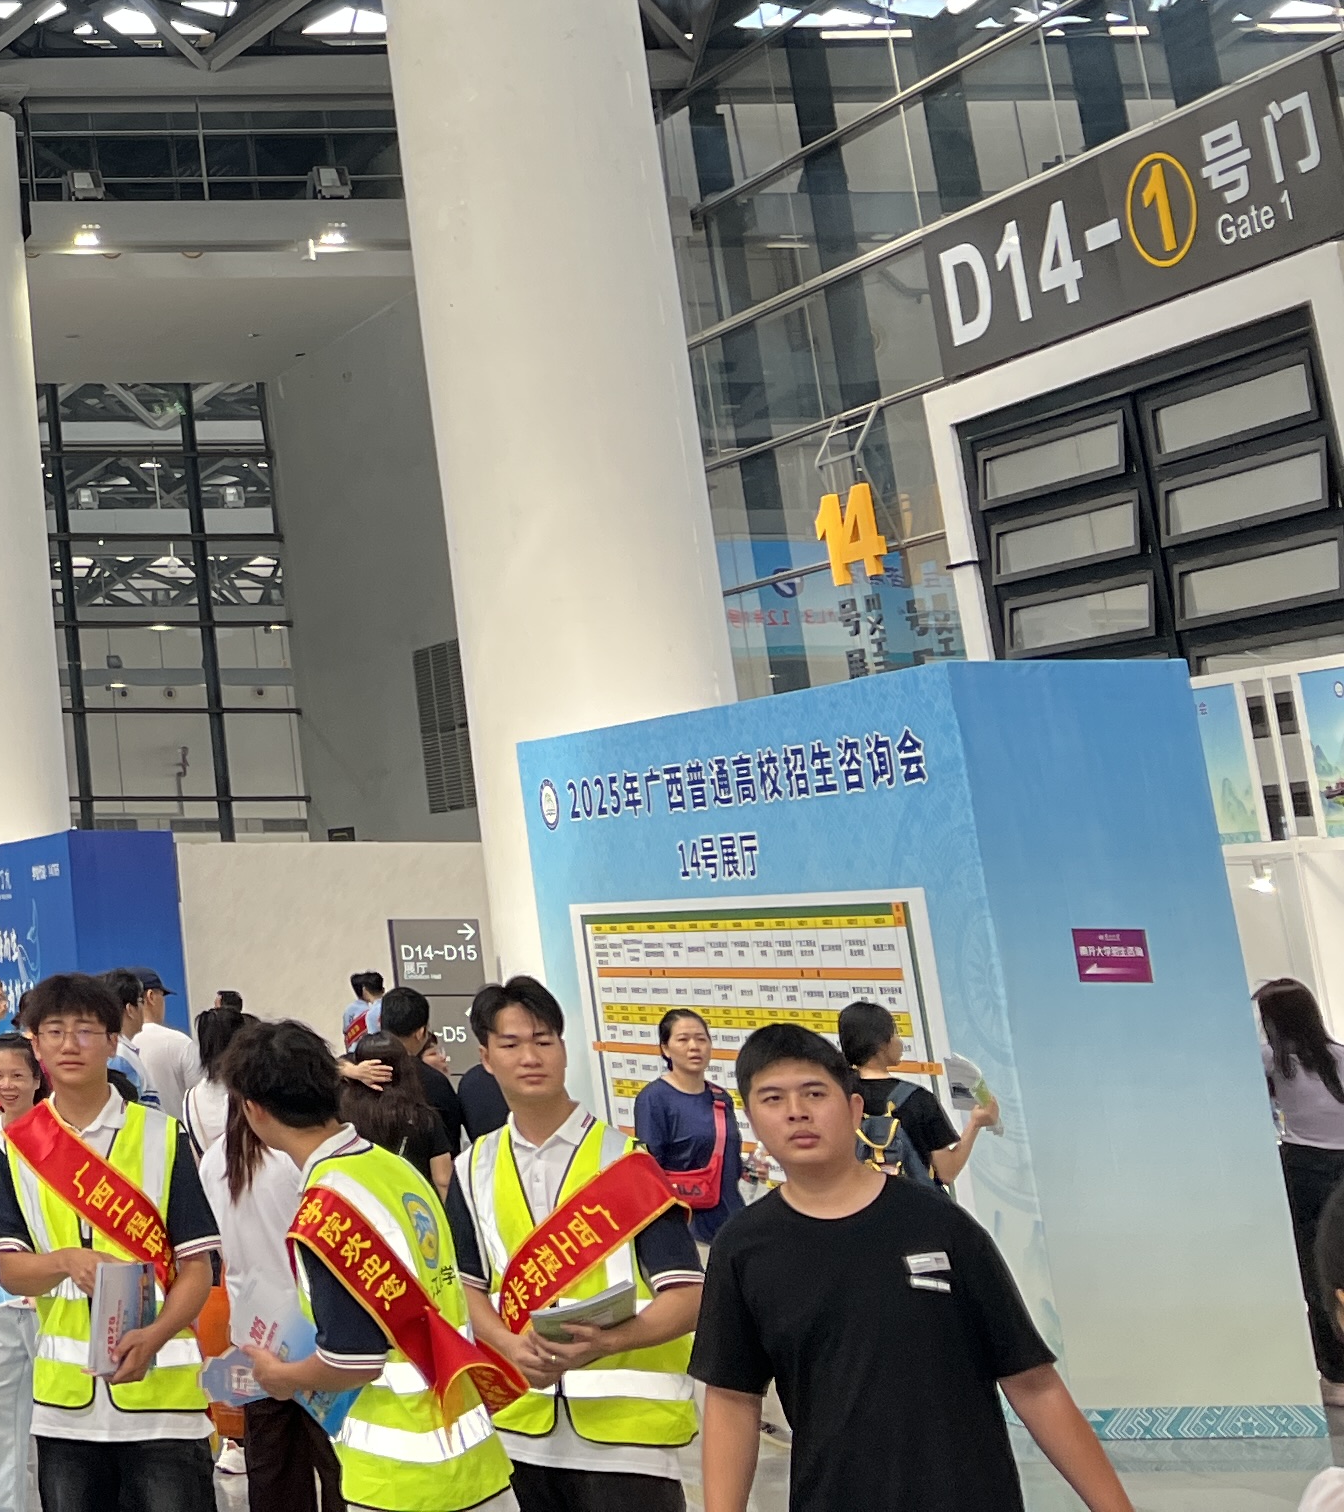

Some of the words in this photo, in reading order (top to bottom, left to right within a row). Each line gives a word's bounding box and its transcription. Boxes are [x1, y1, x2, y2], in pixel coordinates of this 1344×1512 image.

[1217, 204, 1276, 245] Gate
[1280, 190, 1294, 221] 1
[815, 482, 887, 586] 14
[566, 726, 929, 821] 2025年广西普通高校招生咨询会
[676, 831, 760, 881] 14号展厅
[400, 944, 478, 961] D14~D15
[404, 961, 428, 975] 展厅
